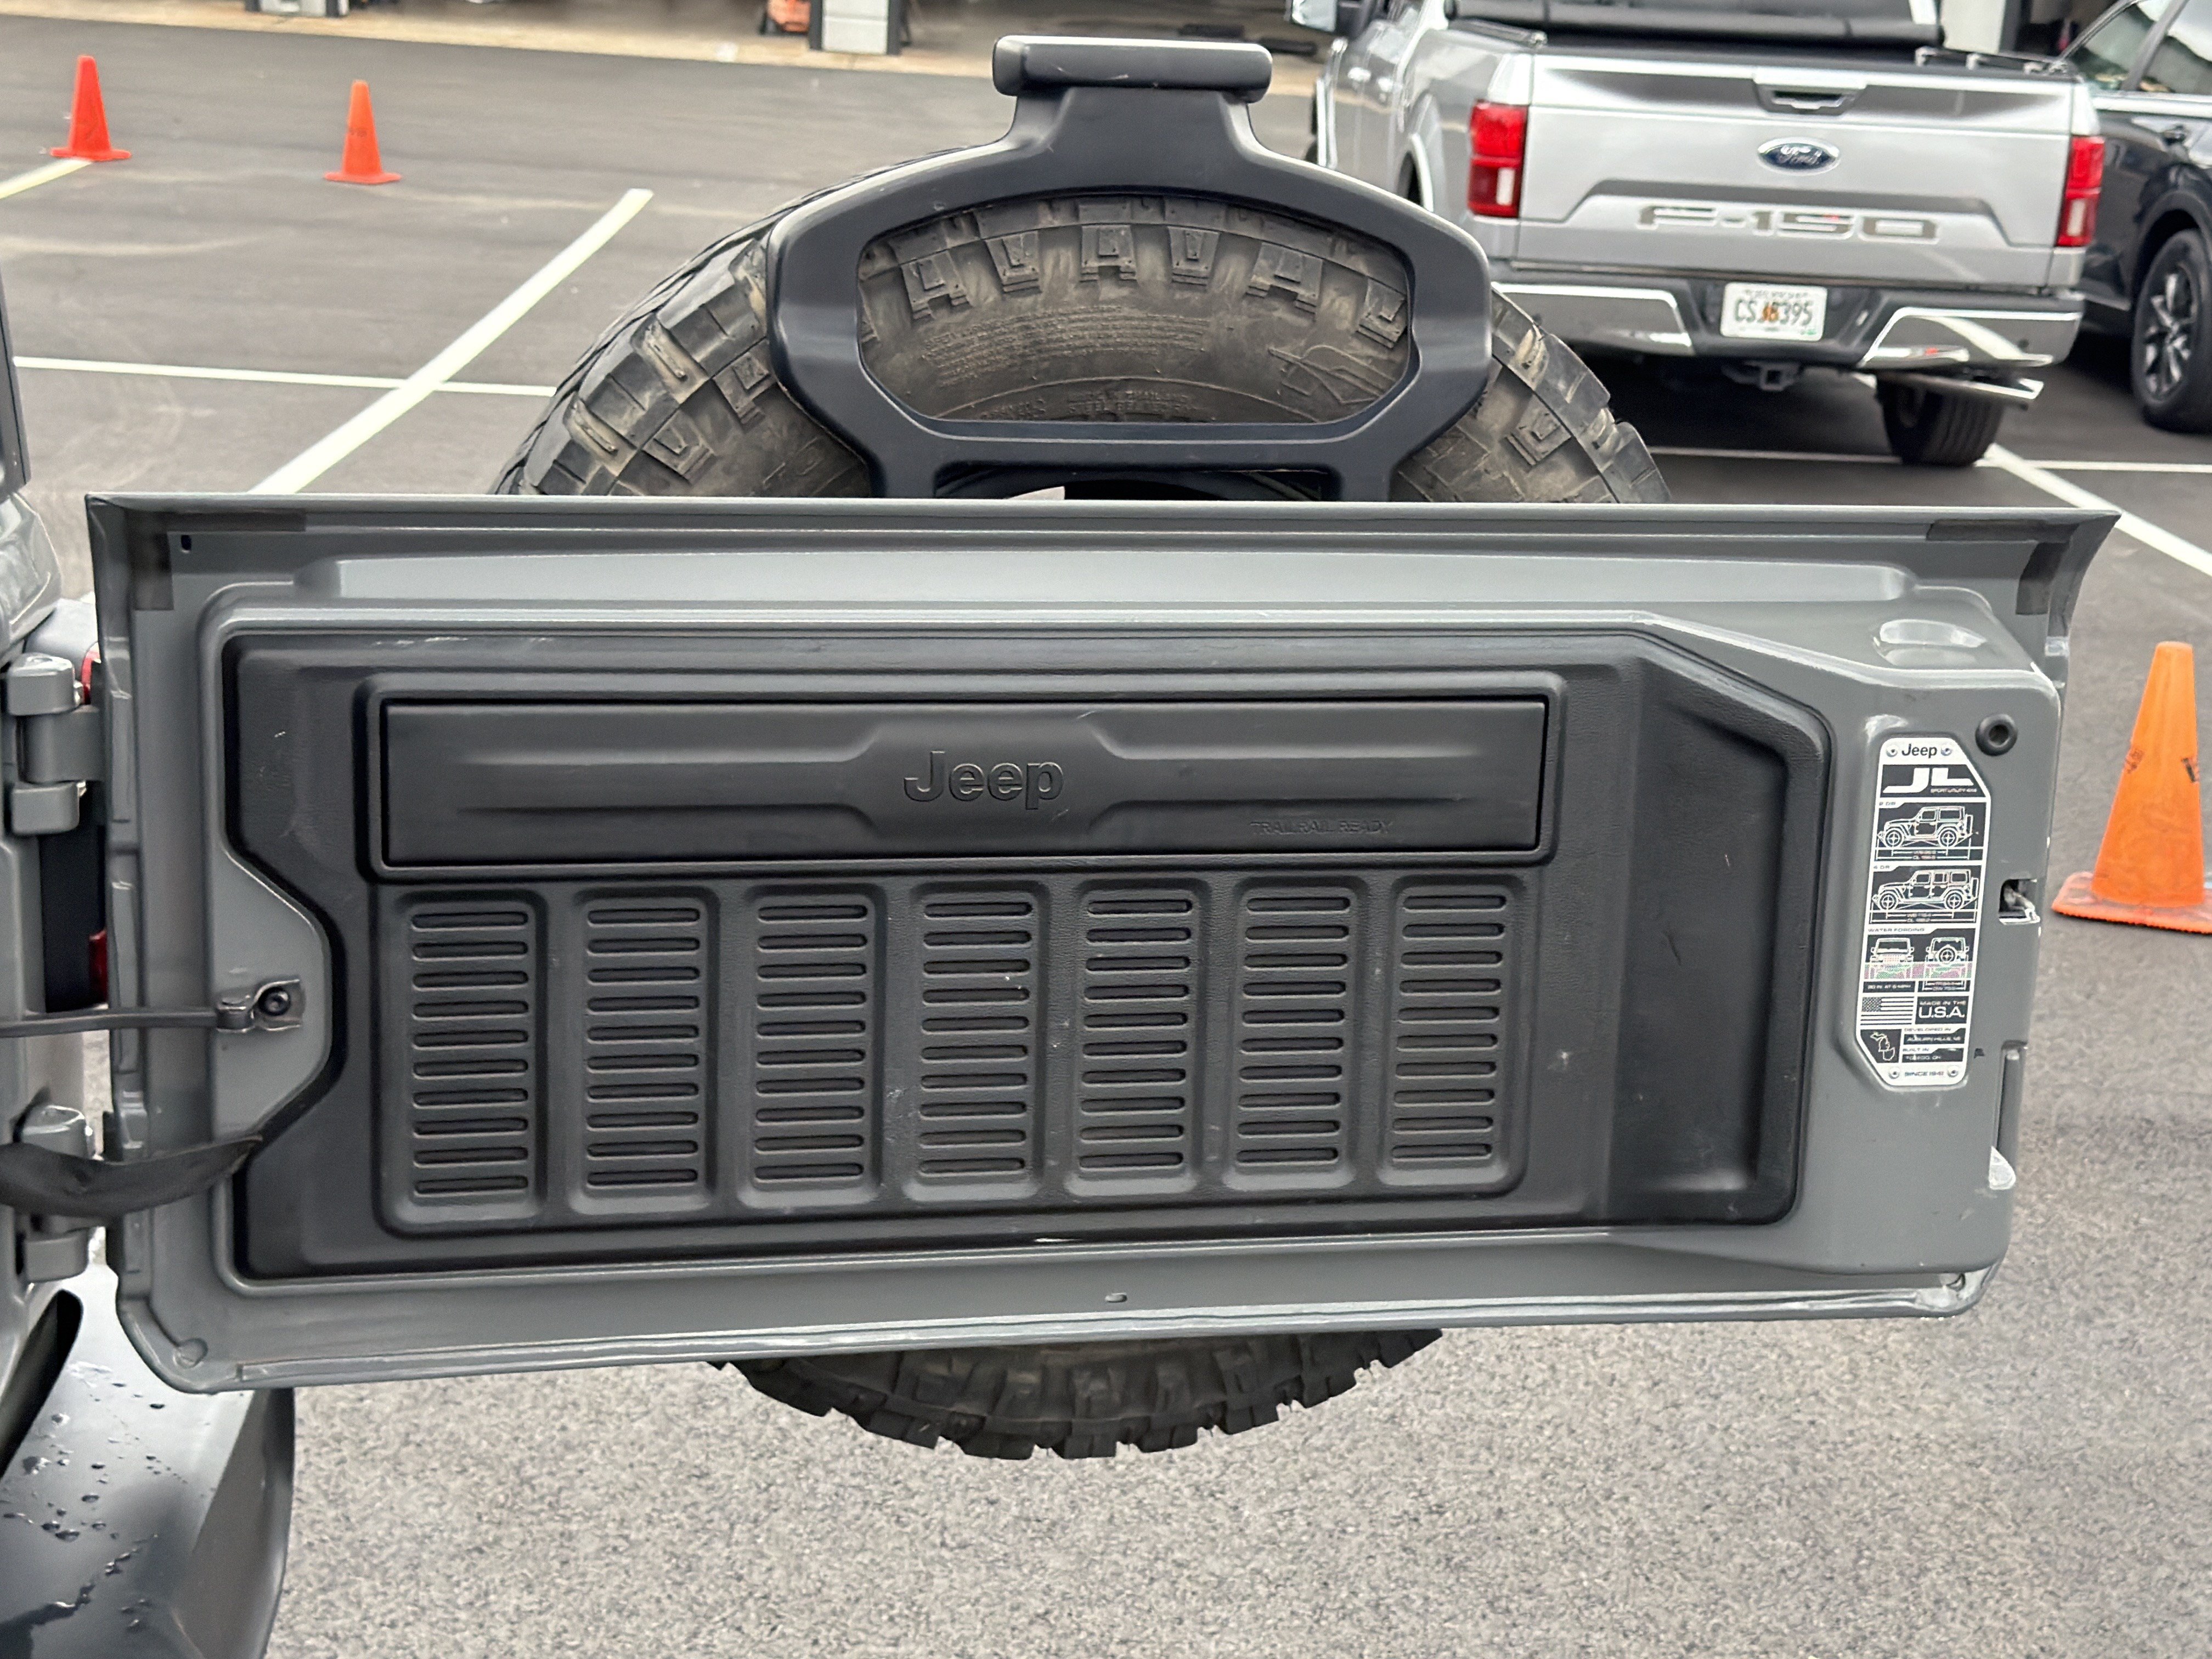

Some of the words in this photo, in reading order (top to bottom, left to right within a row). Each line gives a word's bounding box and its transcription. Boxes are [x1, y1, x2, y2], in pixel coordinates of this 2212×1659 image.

[1637, 204, 1939, 244] F-150
[1901, 743, 1938, 759] Jeep
[903, 750, 1065, 811] Jeep
[1882, 767, 1974, 793] JL
[1918, 1006, 1965, 1019] U.S.A.
